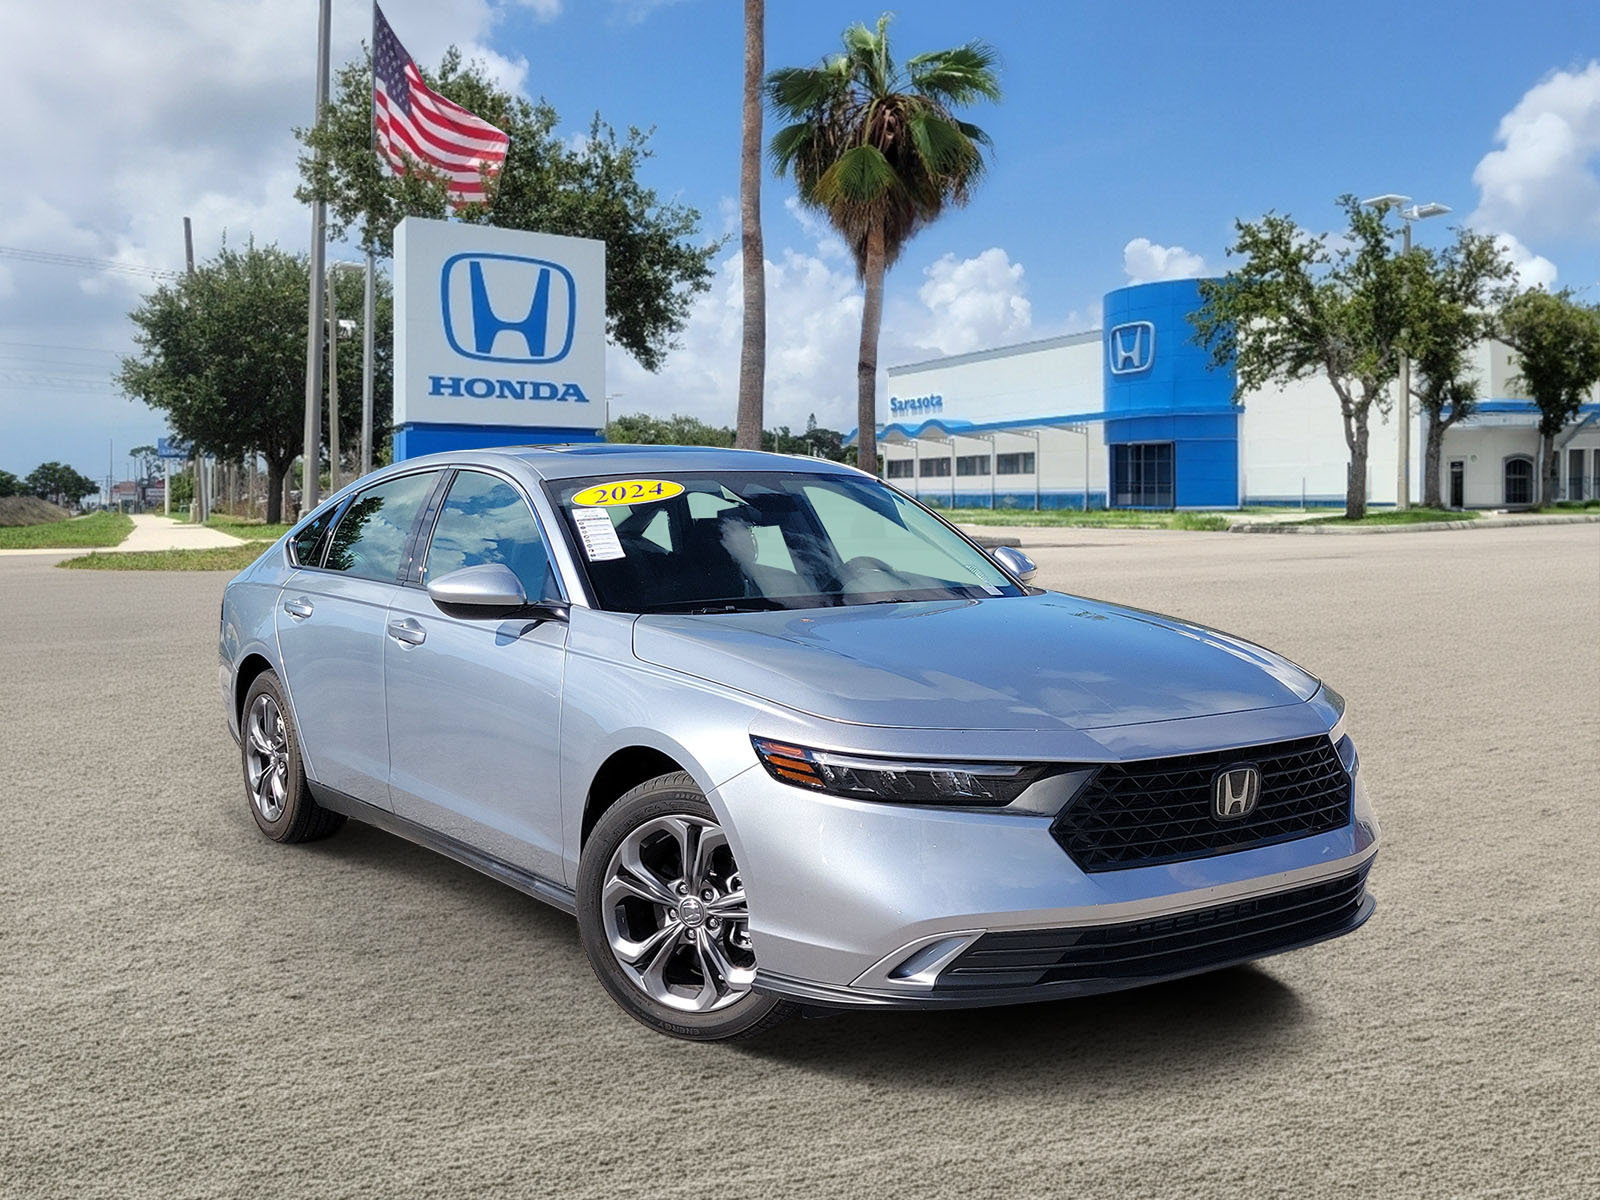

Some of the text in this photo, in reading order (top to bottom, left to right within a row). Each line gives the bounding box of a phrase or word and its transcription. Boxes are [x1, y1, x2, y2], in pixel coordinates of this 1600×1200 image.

[428, 375, 589, 403] HONDA
[890, 393, 943, 412] Sarasota
[594, 482, 664, 504] 2024
[657, 1020, 700, 1037] ENERGY
